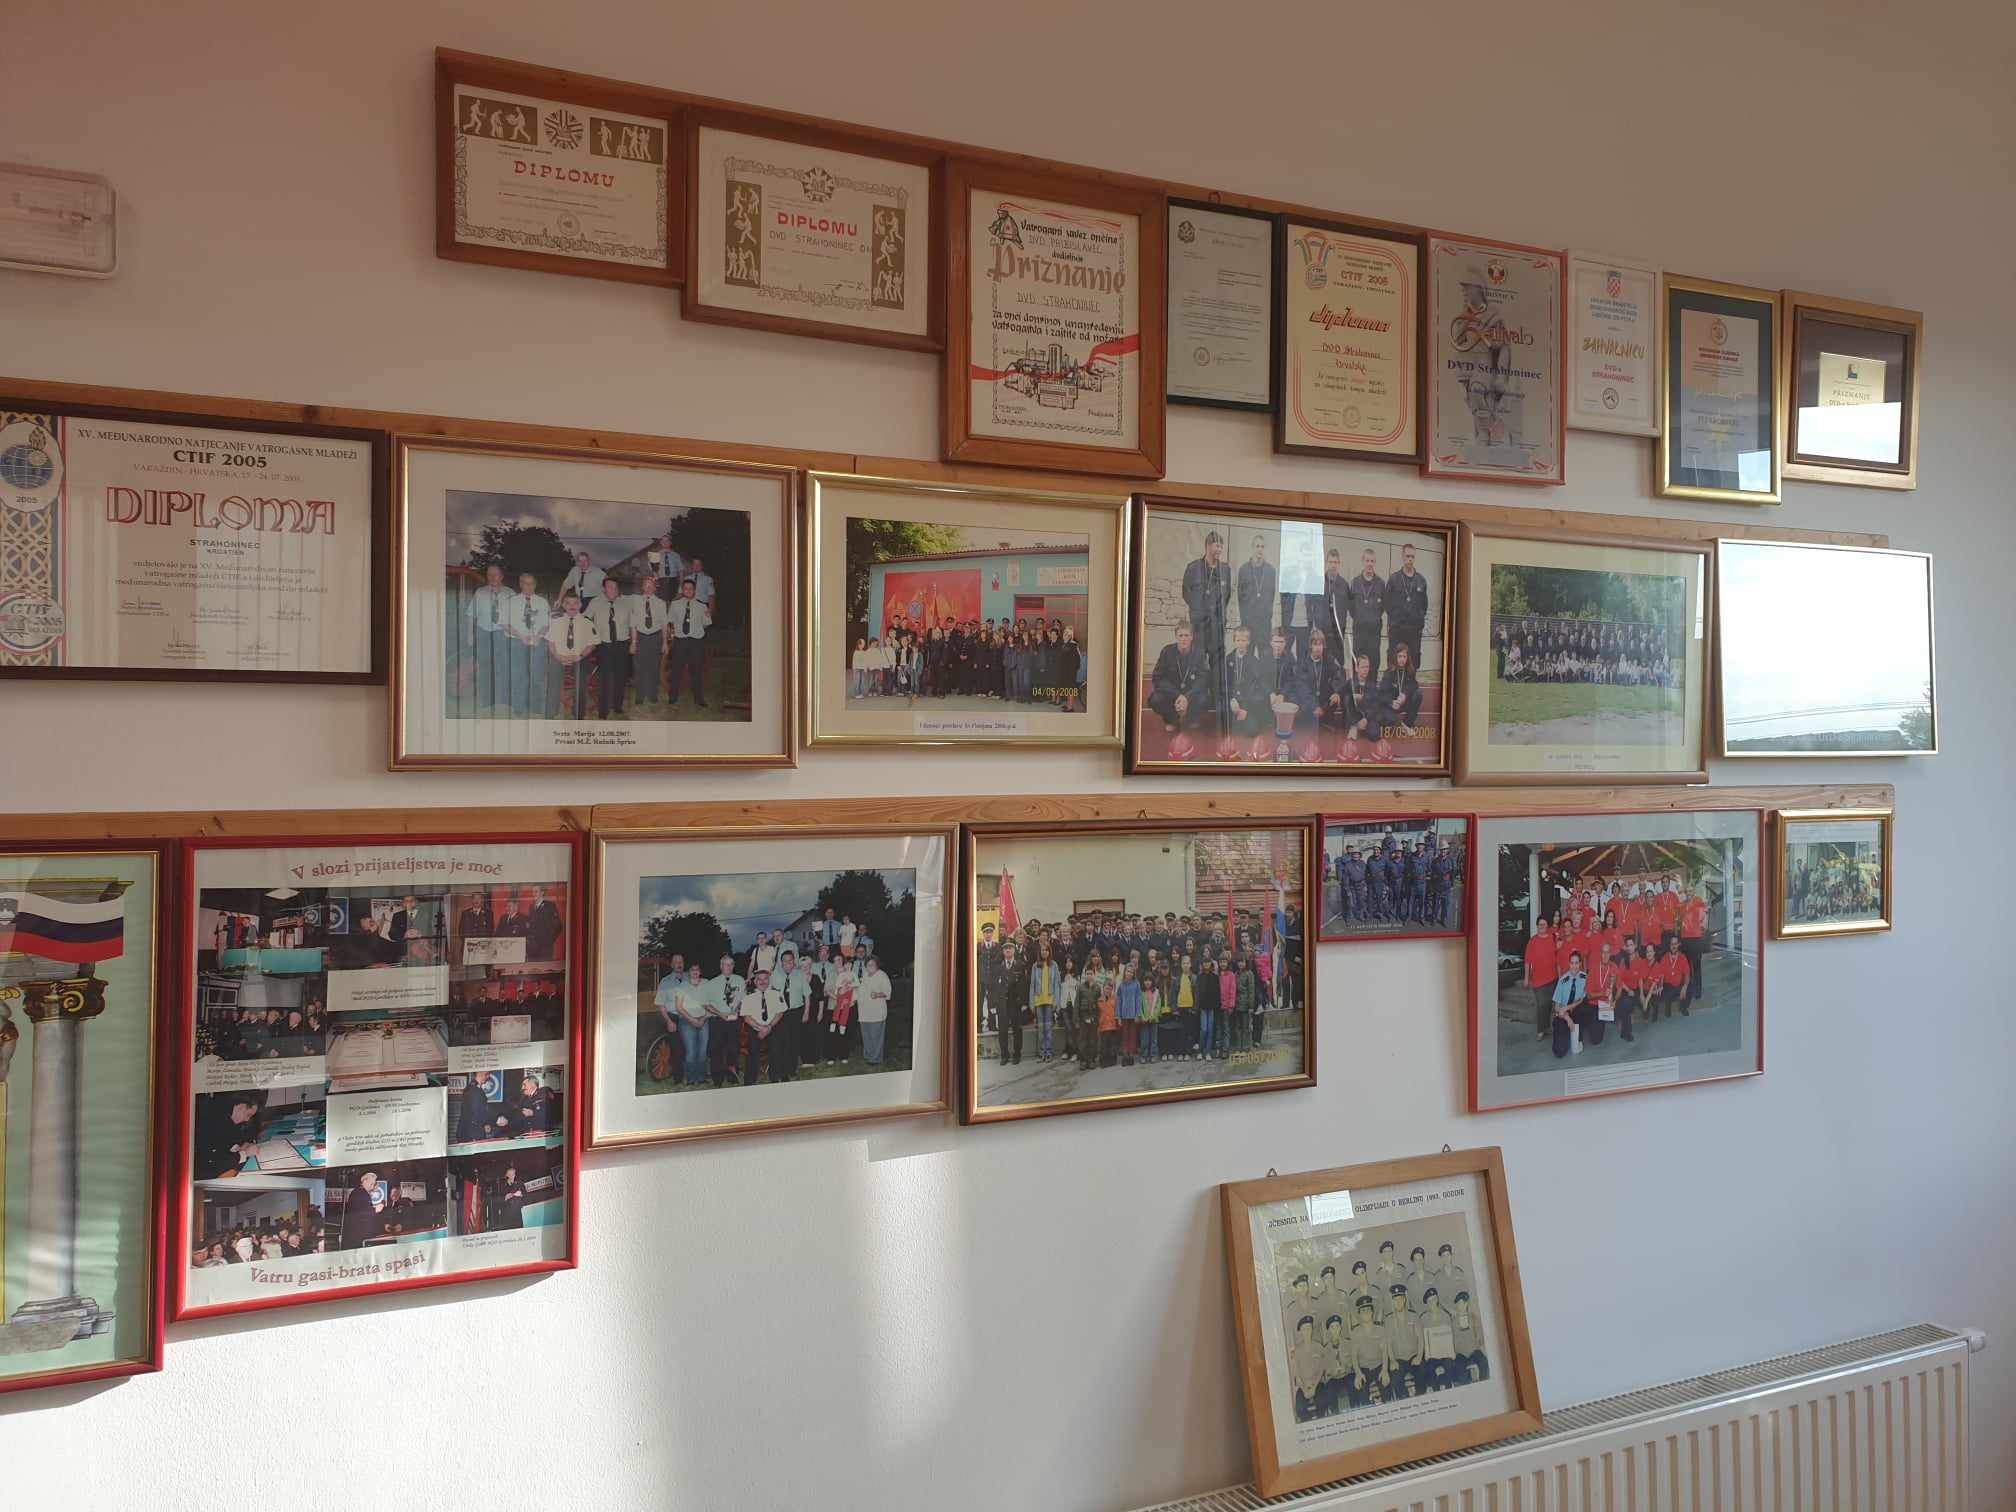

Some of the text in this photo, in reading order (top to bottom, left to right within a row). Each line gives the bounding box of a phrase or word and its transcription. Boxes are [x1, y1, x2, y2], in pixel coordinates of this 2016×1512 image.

[513, 160, 615, 188] DIPLOMU
[777, 211, 858, 237] DIPLOMU
[987, 238, 1126, 294] Priznanje
[1447, 359, 1543, 380] DVD Strahoninec
[99, 431, 183, 446] MEĐUNARODNO
[248, 443, 314, 457] VATROGASNE
[173, 450, 268, 469] CTIF 2005
[106, 486, 336, 535] DIPLOMA
[190, 539, 262, 550] STRAHONINEC
[291, 864, 304, 880] V
[311, 859, 350, 878] slozi
[353, 857, 447, 877] prijateljstva
[449, 857, 464, 874] je
[250, 1250, 426, 1287] Vatru gasi-brata spasi
